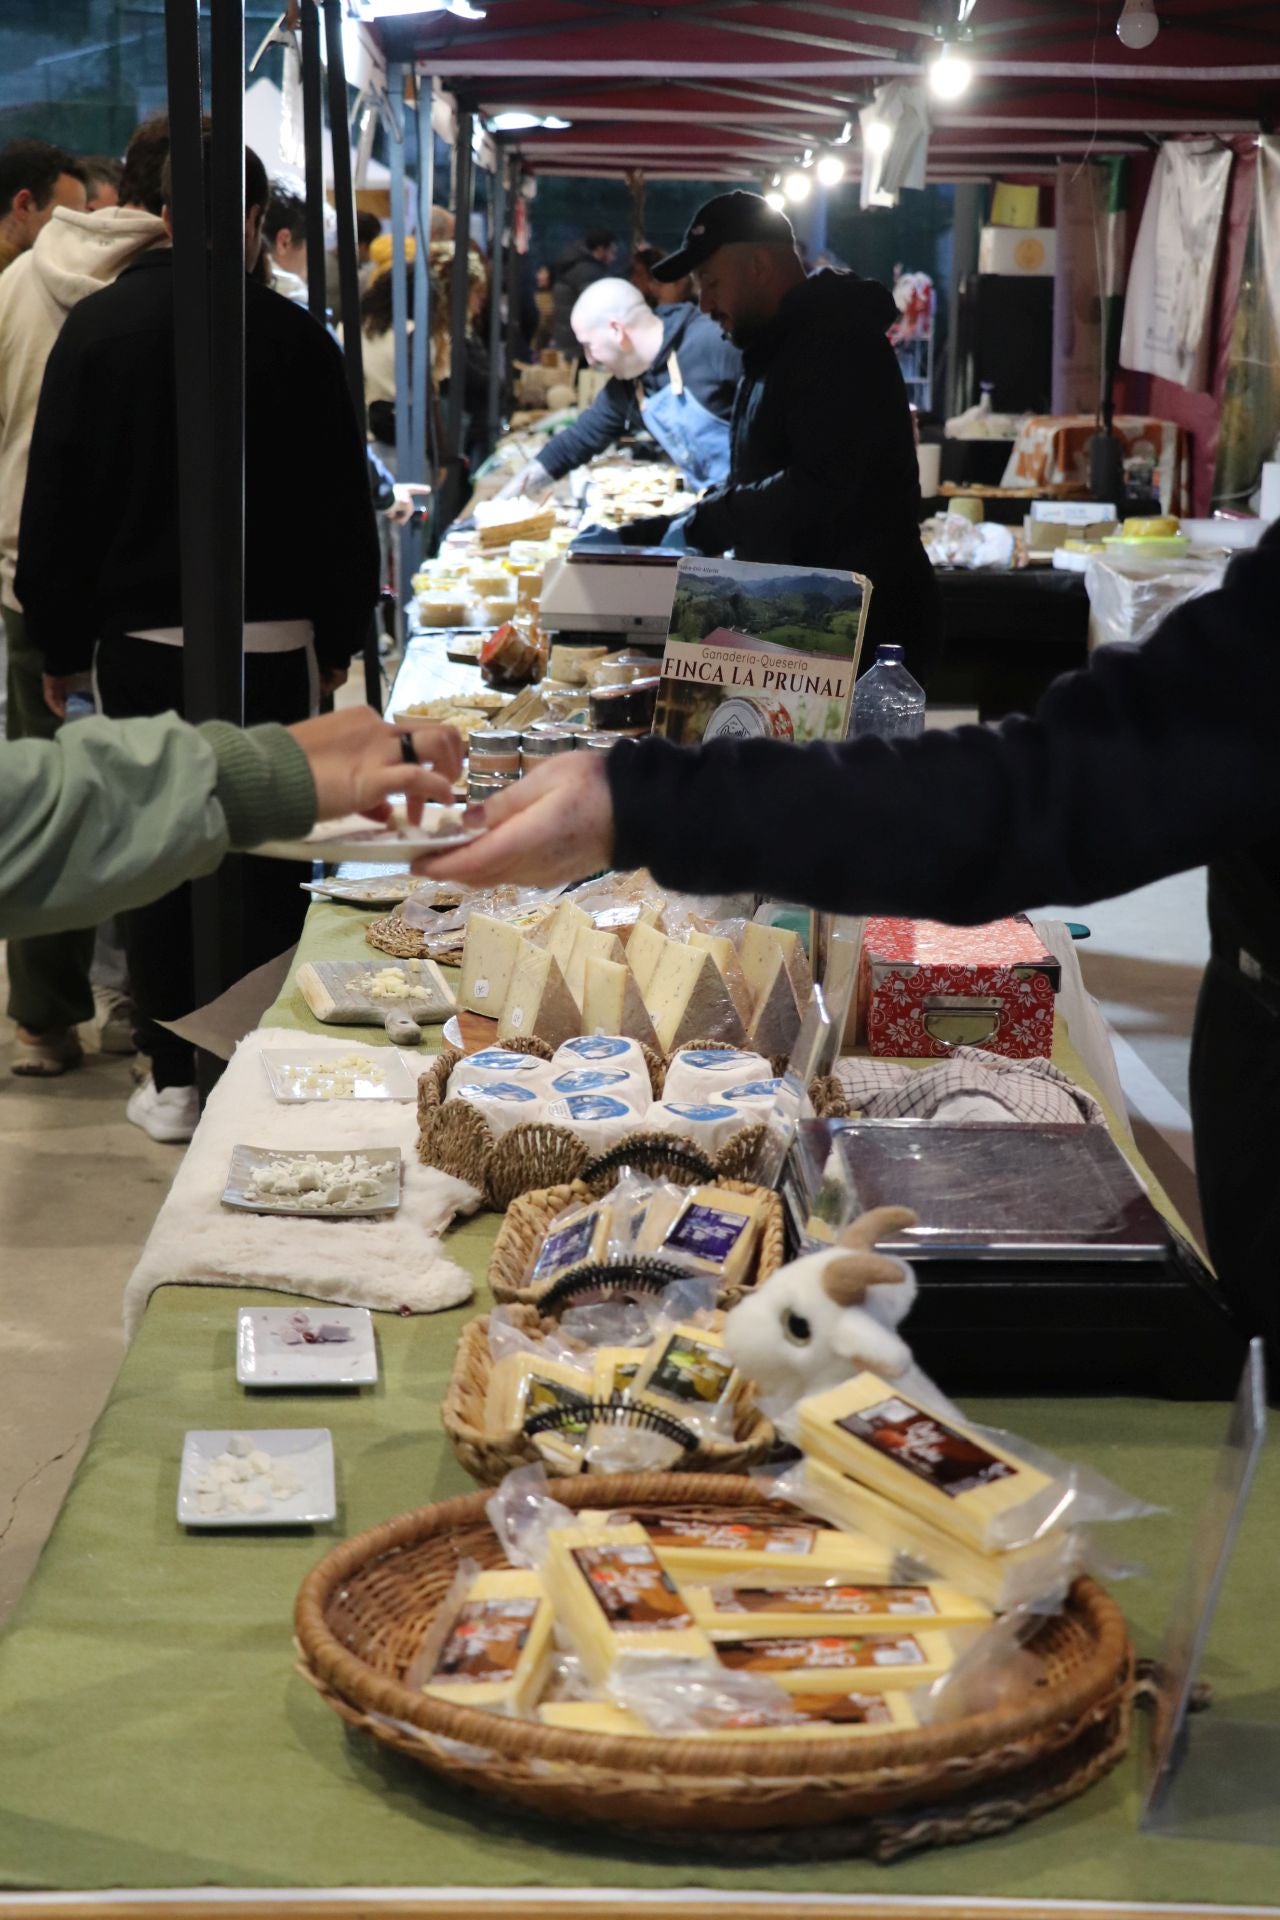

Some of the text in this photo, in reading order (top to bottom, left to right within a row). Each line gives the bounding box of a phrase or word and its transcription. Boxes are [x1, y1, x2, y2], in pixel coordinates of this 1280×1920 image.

[664, 657, 846, 698] FINCA LA PRUNAL
